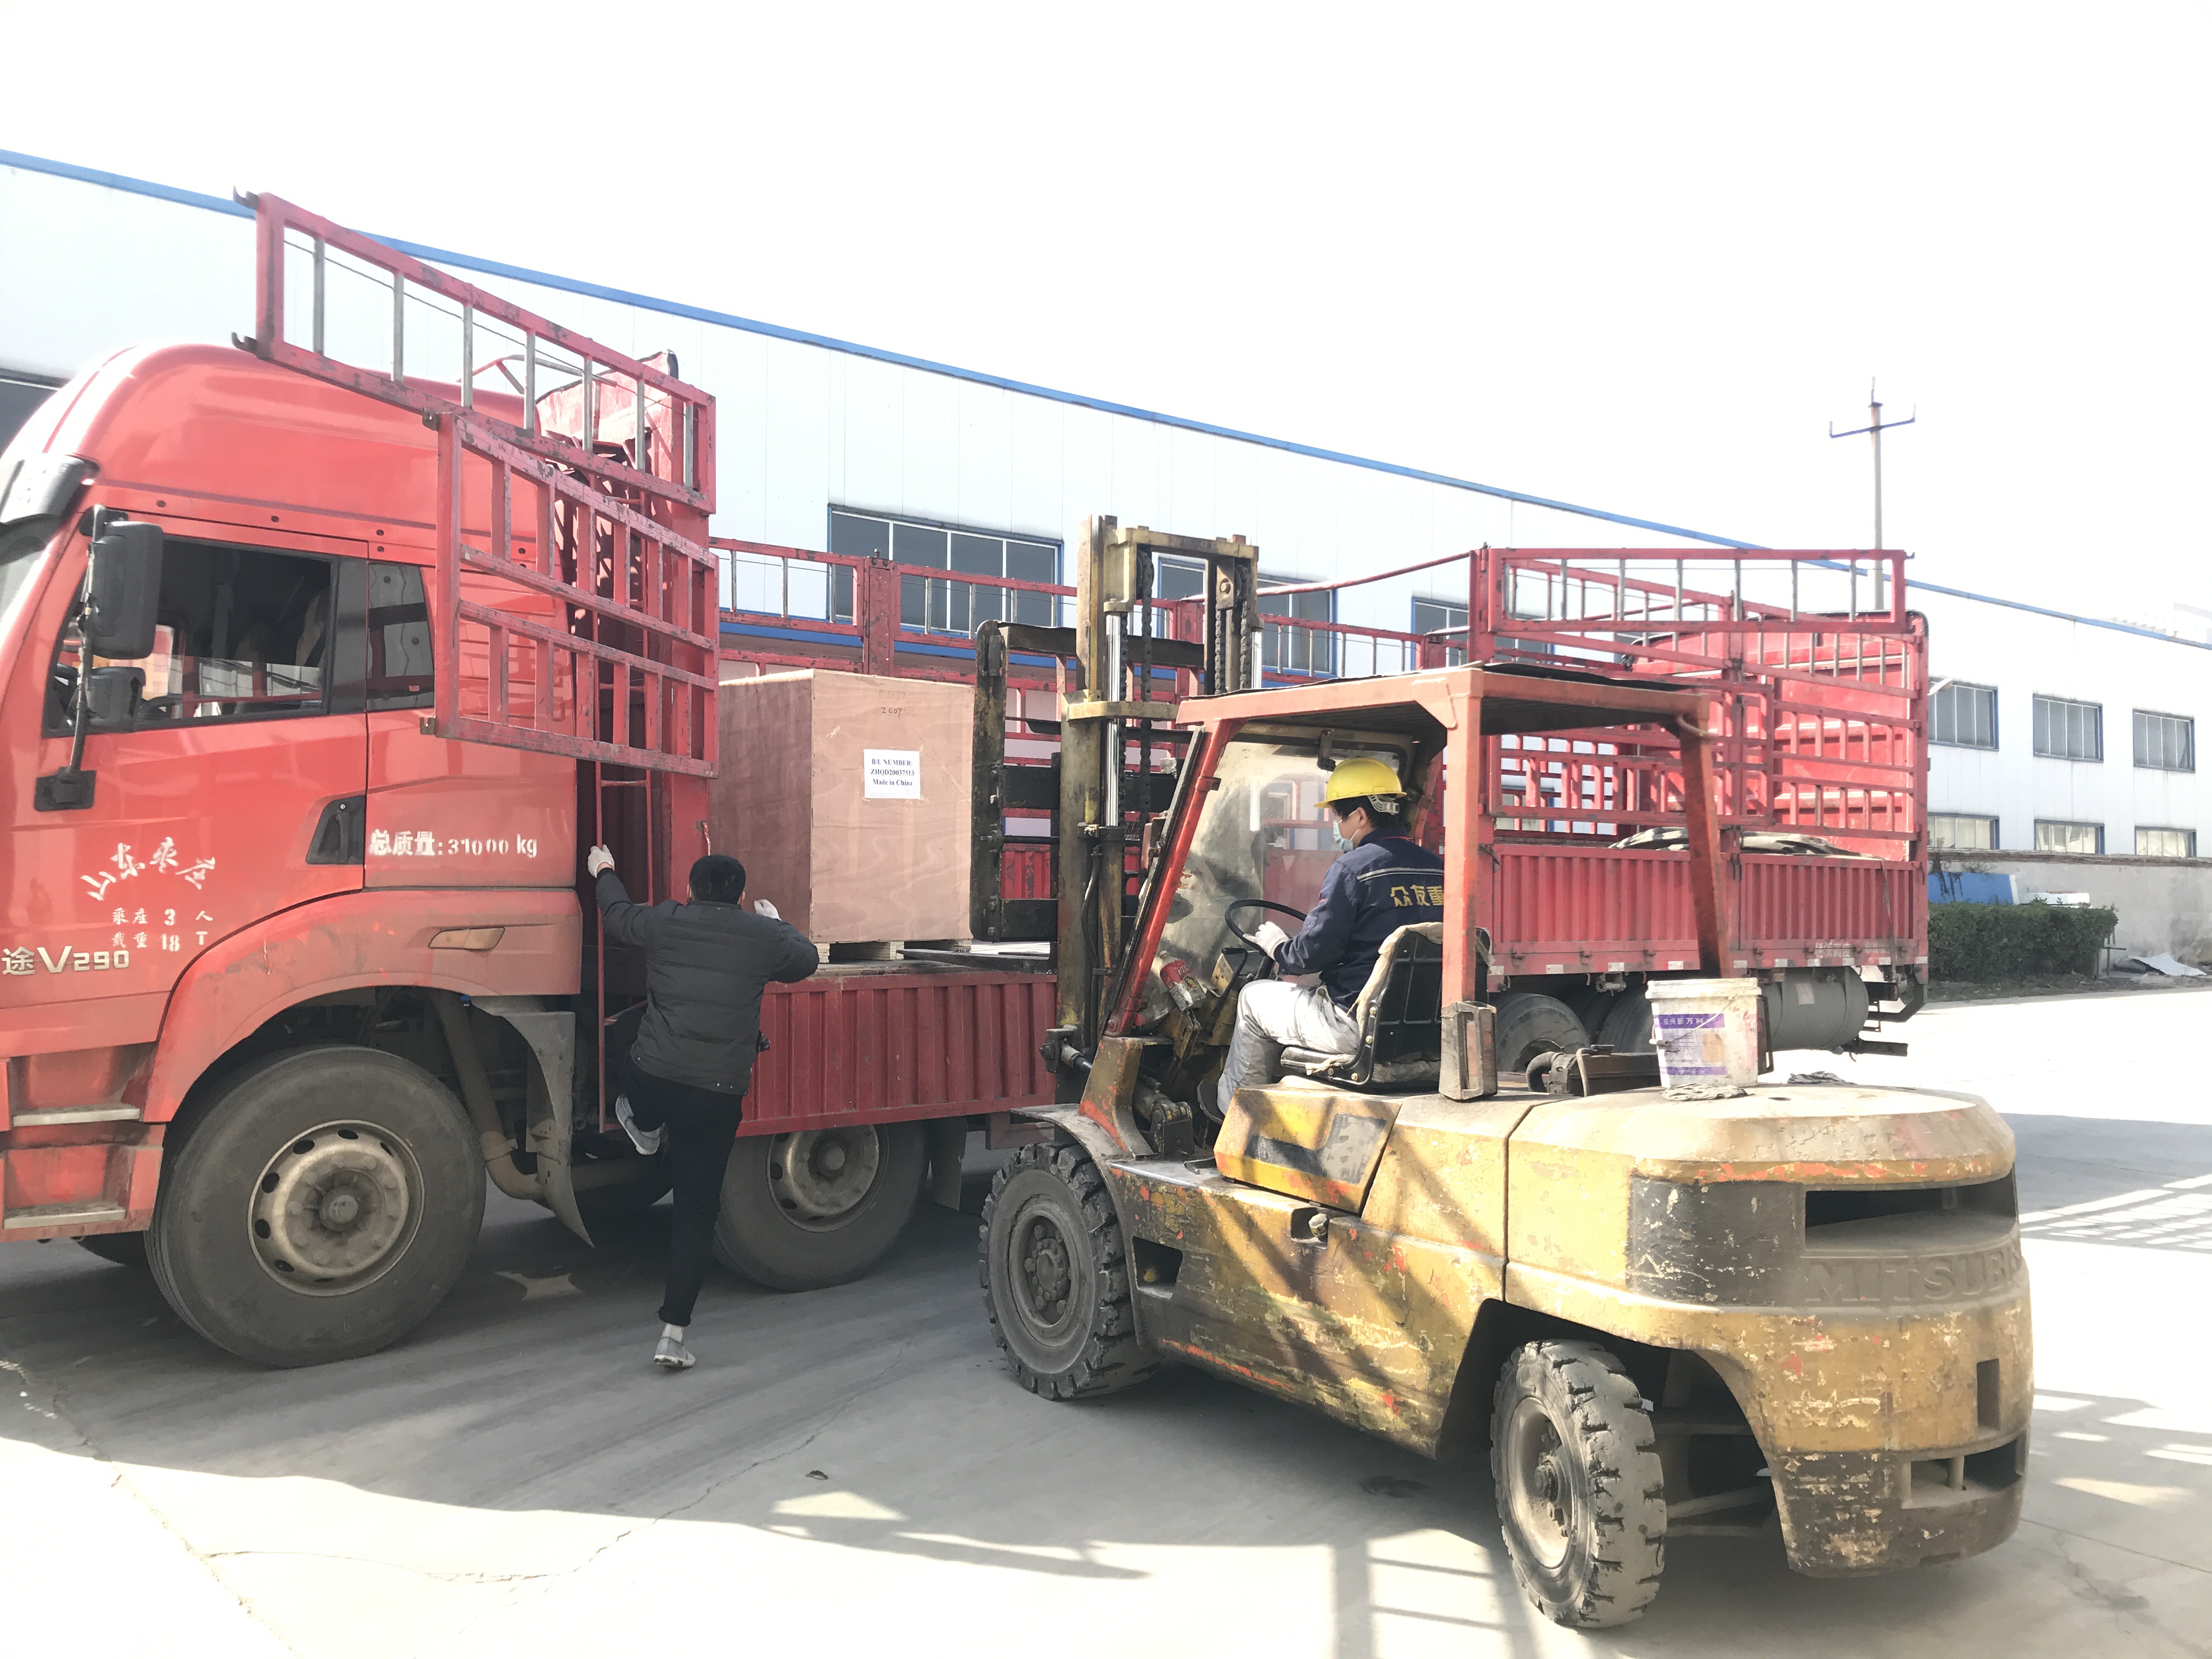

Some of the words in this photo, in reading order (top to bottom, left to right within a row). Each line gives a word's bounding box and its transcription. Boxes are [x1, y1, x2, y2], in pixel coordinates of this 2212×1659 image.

[516, 833, 538, 859] kg
[165, 908, 176, 926] 3
[195, 910, 213, 922] 人
[161, 933, 180, 952] 18
[195, 930, 209, 946] T
